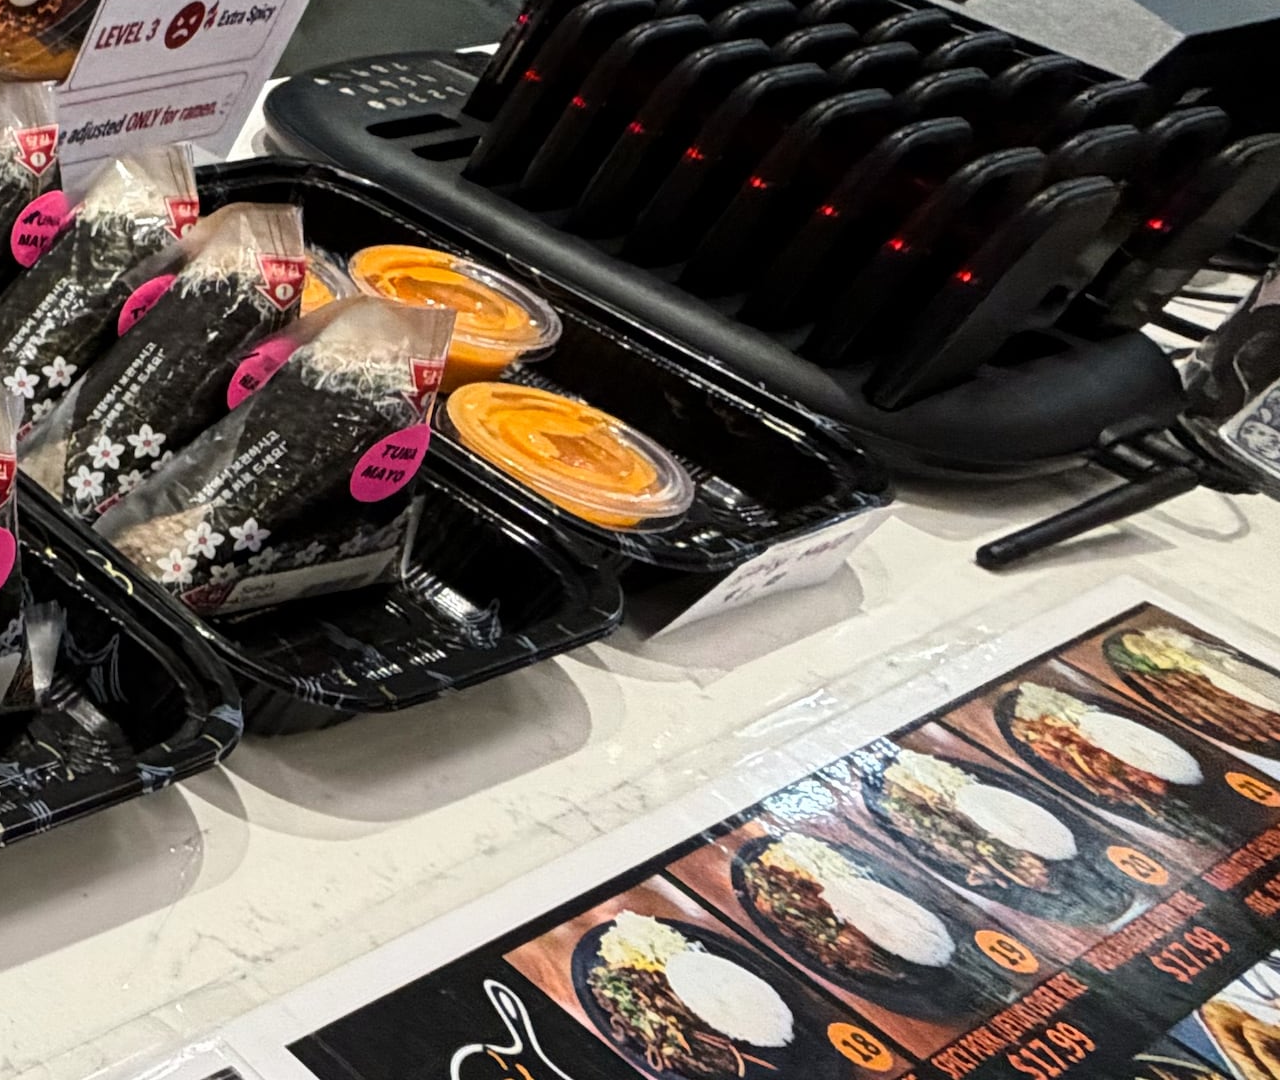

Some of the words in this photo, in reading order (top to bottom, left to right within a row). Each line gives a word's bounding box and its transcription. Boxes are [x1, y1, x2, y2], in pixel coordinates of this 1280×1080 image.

[93, 20, 146, 52] LEVEL
[145, 19, 159, 42] 3
[216, 6, 246, 29] Extra
[245, 2, 278, 25] Spicy
[66, 113, 124, 147] adjusted
[125, 107, 159, 134] ONLY
[159, 107, 177, 127] for
[176, 99, 218, 121] ramen.
[17, 232, 50, 249] MAY
[381, 443, 419, 461] TUNA
[360, 465, 407, 485] MAYO
[1119, 853, 1157, 880] 20
[988, 936, 1028, 966] 19
[1148, 925, 1232, 985] $17.99
[840, 1030, 882, 1065] 18
[930, 1042, 980, 1080] SPICY
[958, 1025, 1008, 1063] PORK
[1022, 985, 1070, 1018] OVER
[1006, 1021, 1097, 1080] $17.99
